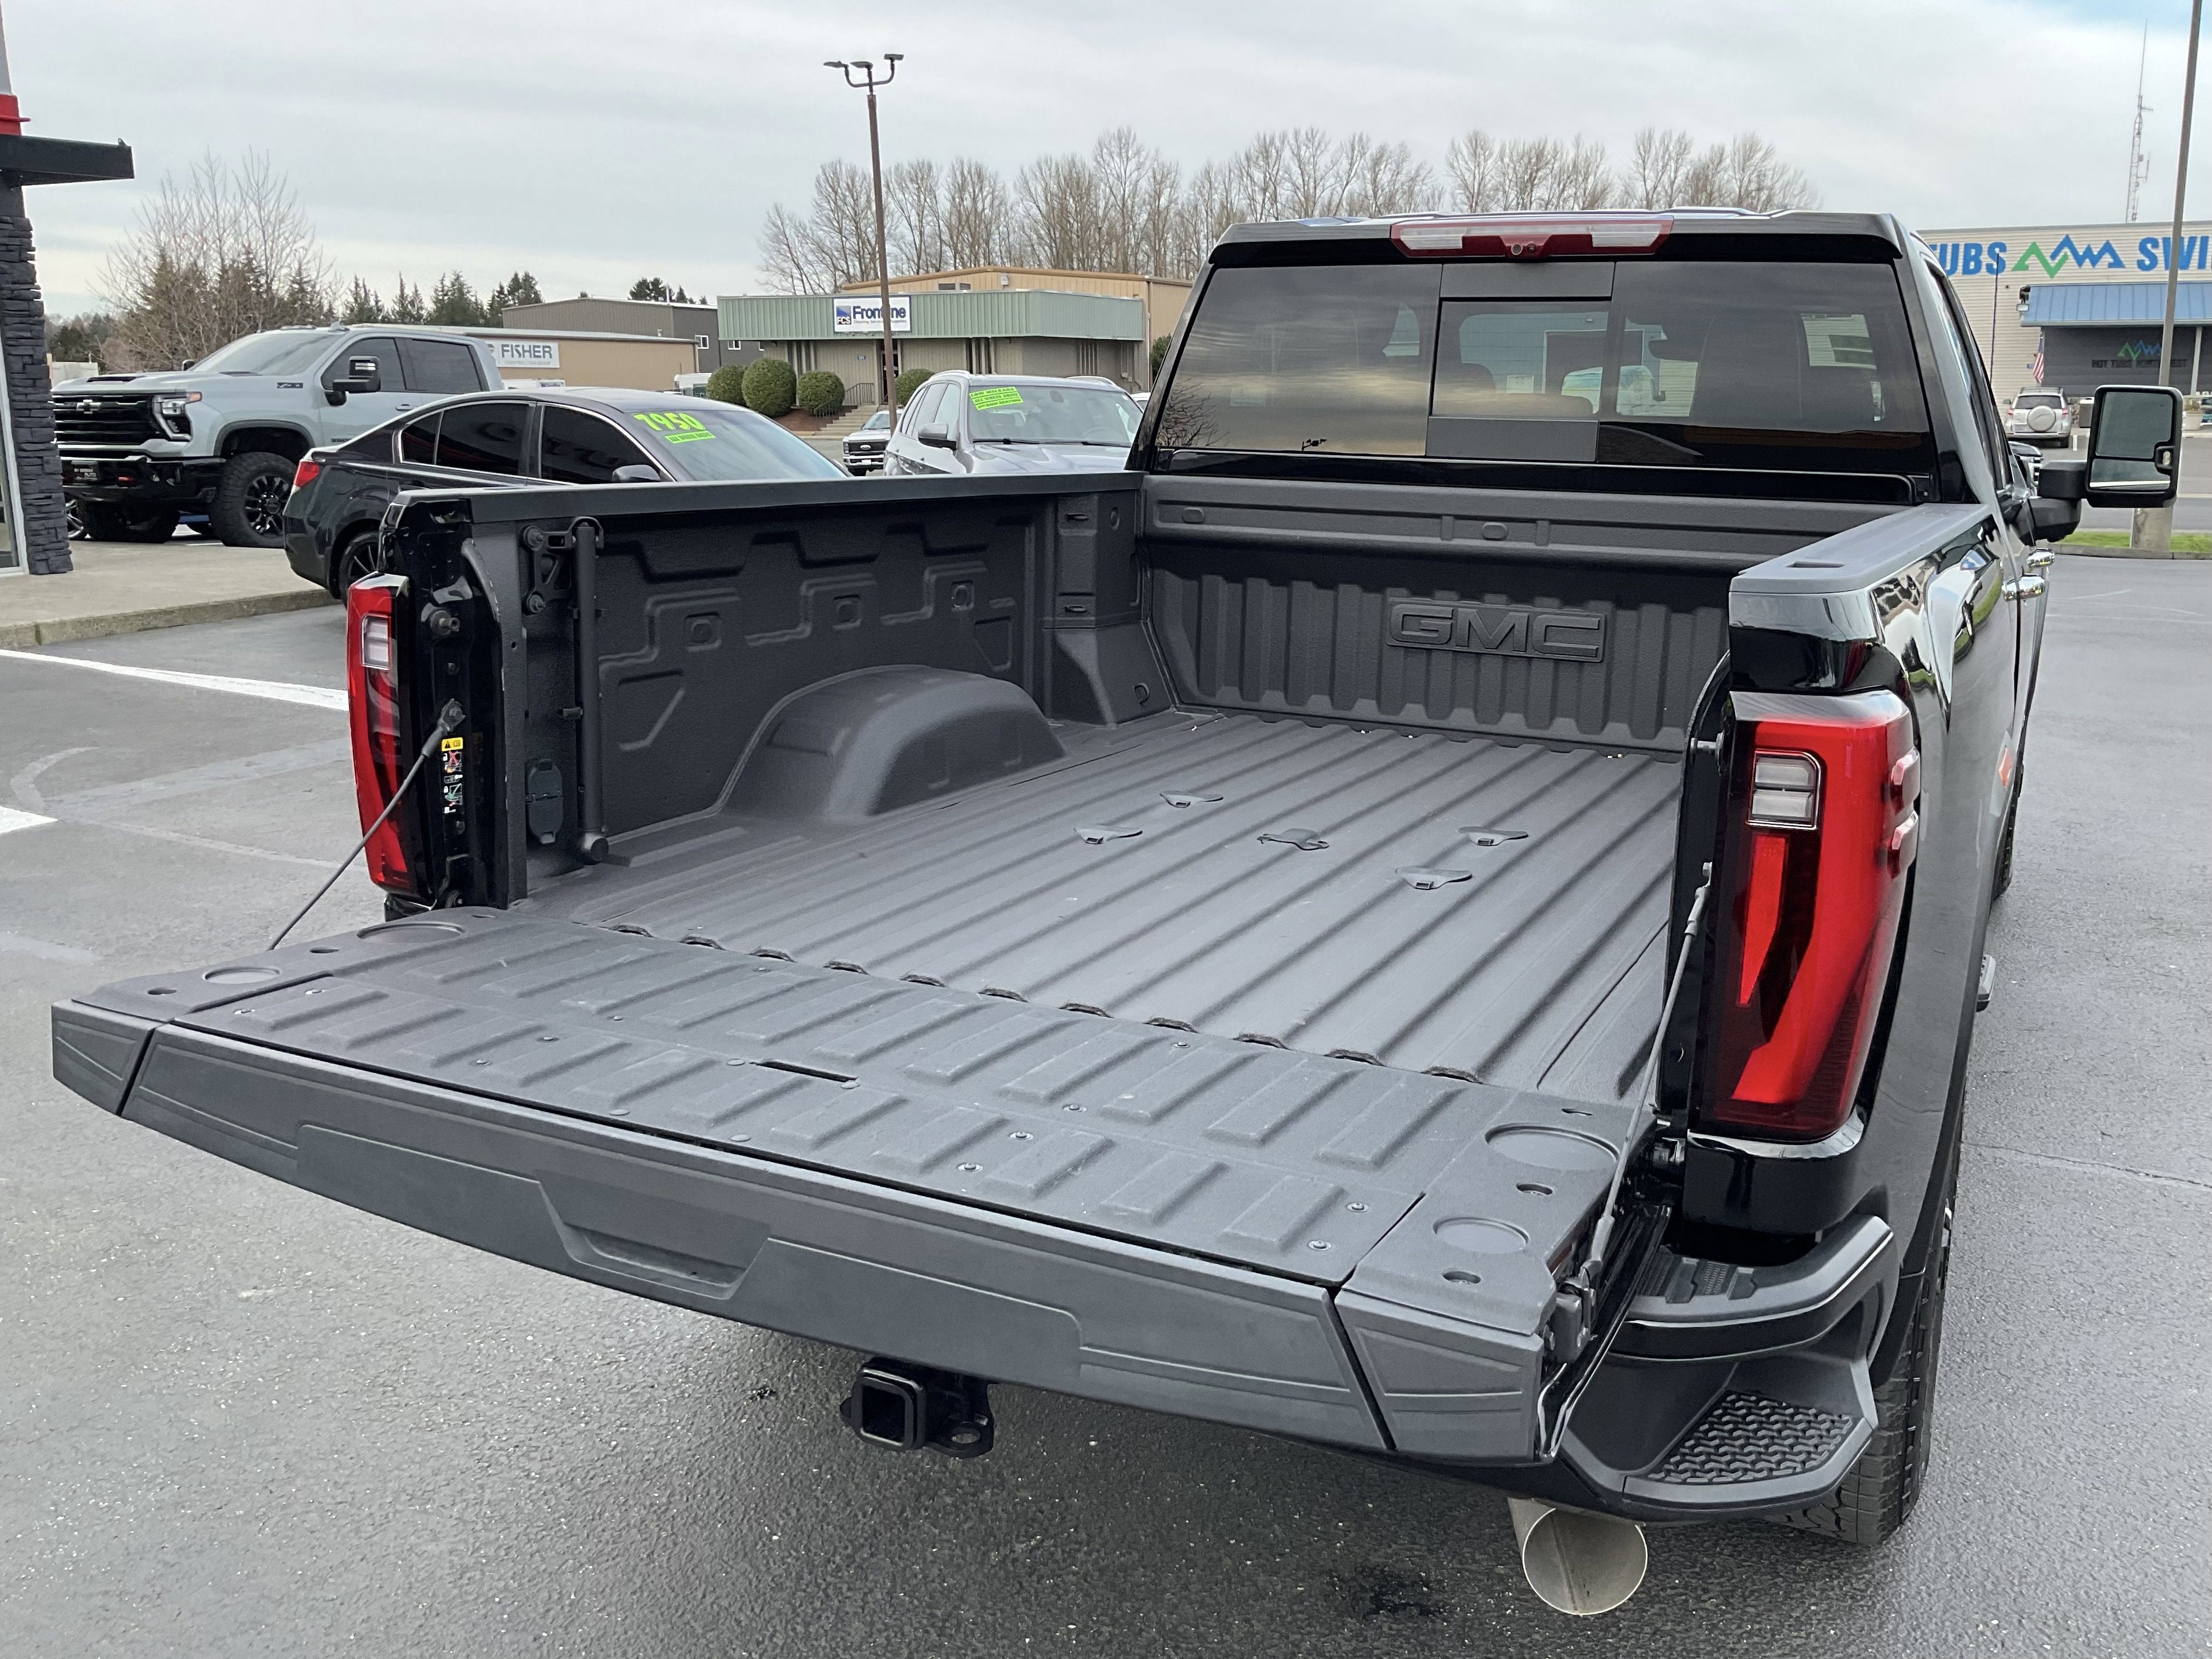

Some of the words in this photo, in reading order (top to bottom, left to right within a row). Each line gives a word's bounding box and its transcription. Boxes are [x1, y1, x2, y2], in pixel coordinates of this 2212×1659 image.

[837, 316, 851, 324] FCS
[501, 344, 552, 359] FISHER
[1391, 604, 1600, 658] GMC
